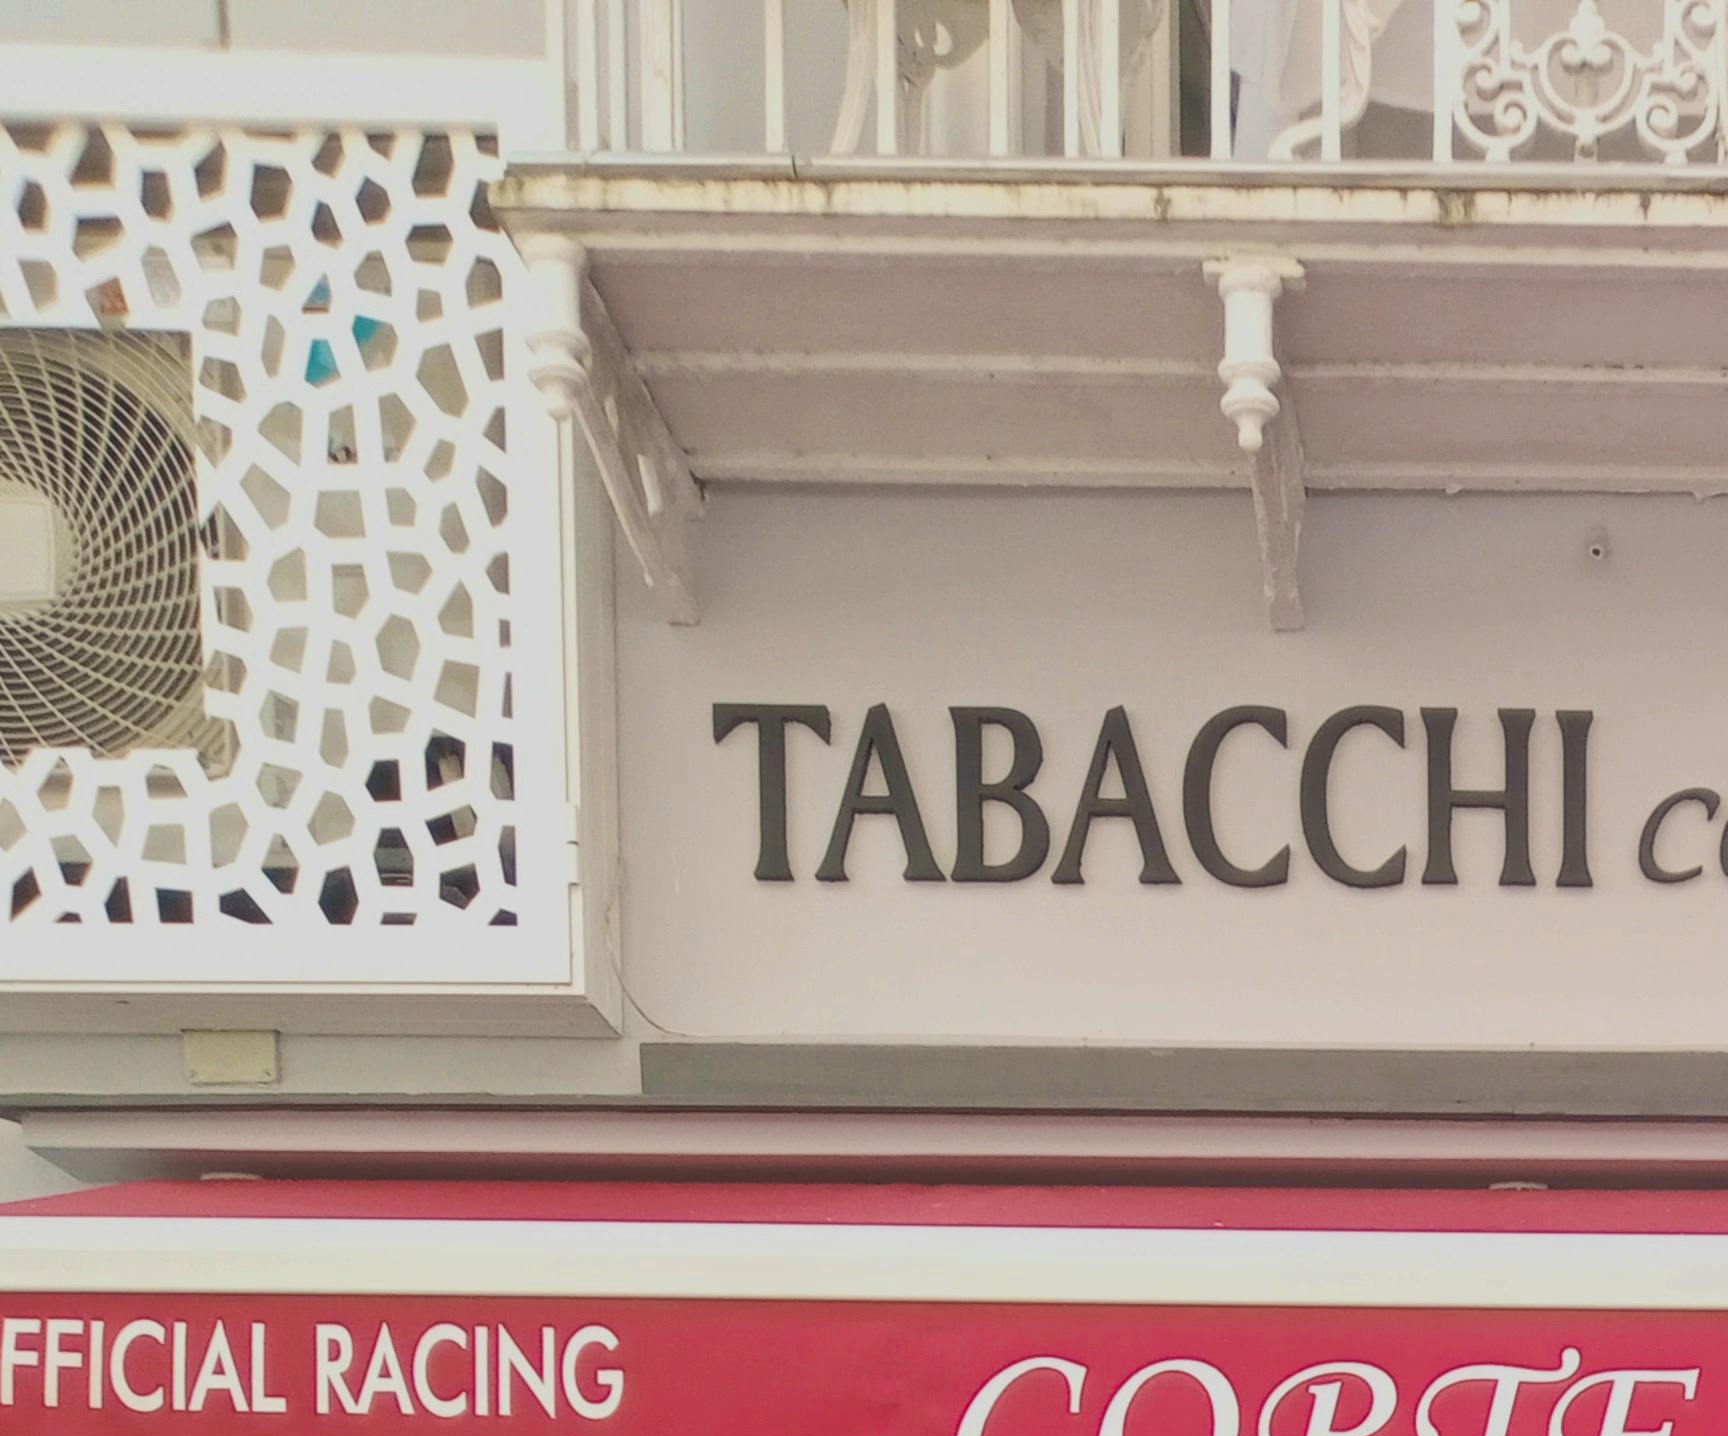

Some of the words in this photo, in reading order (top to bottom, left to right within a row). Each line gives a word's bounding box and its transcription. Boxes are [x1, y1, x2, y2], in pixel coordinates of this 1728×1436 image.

[712, 702, 1595, 888] TABACCHI
[1, 1317, 288, 1414] FFICIAL
[315, 1320, 625, 1420] RACING
